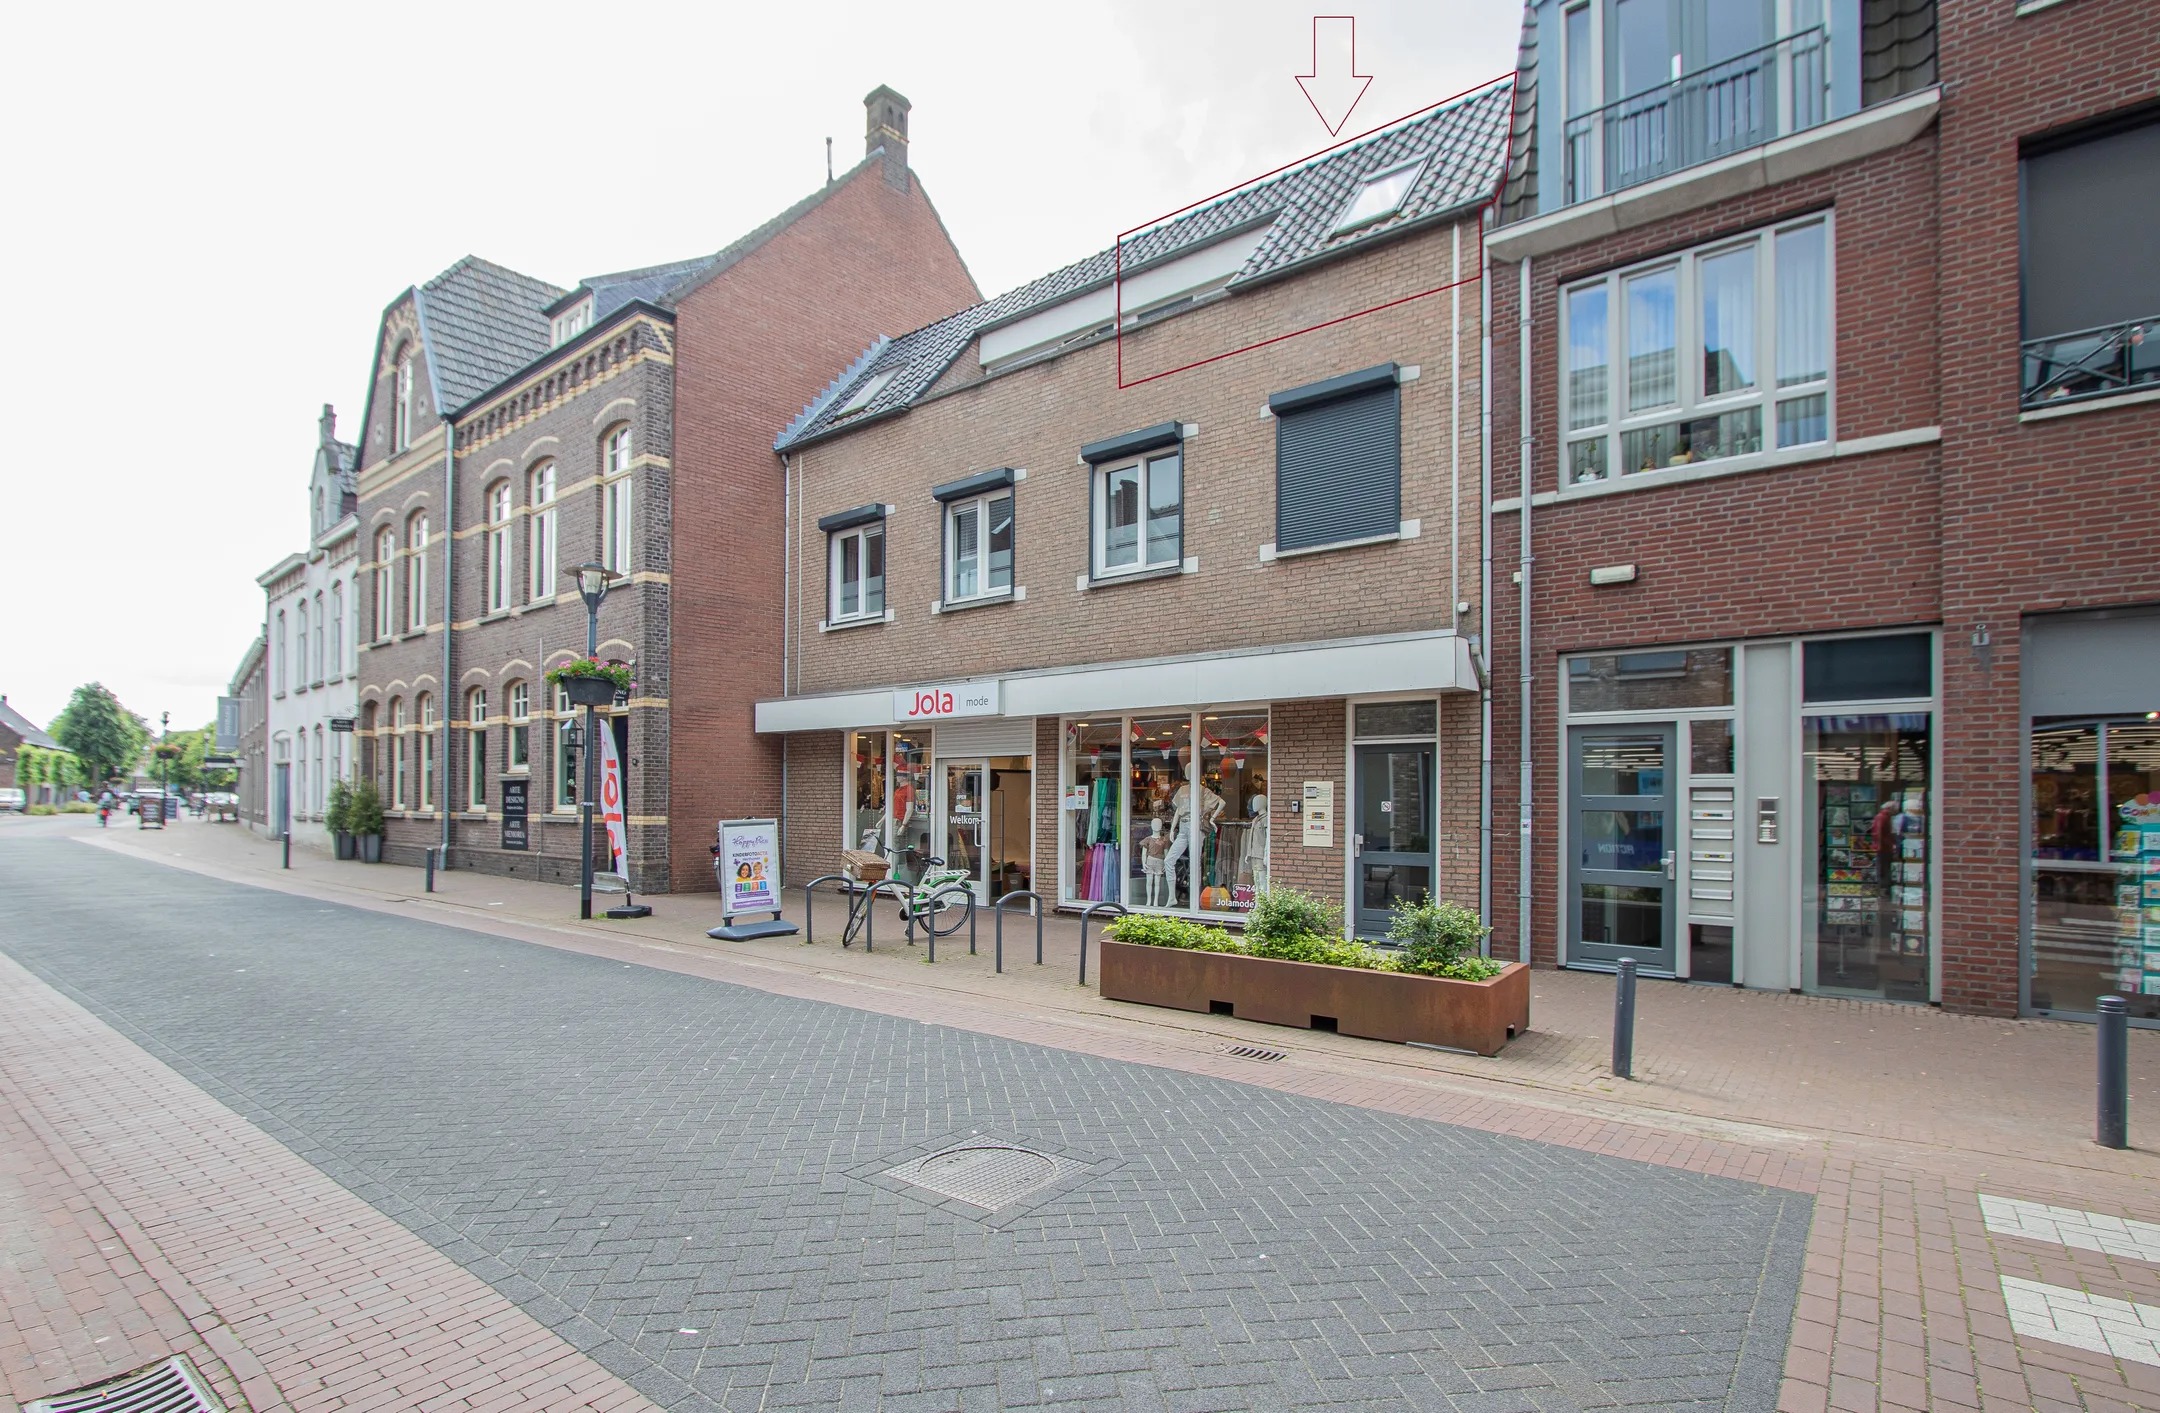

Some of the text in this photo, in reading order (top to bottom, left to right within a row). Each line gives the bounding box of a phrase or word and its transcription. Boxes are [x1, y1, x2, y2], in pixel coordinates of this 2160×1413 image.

[909, 689, 989, 716] Jola mode
[950, 815, 980, 825] Welkom
[1216, 898, 1255, 908] Jolamode
